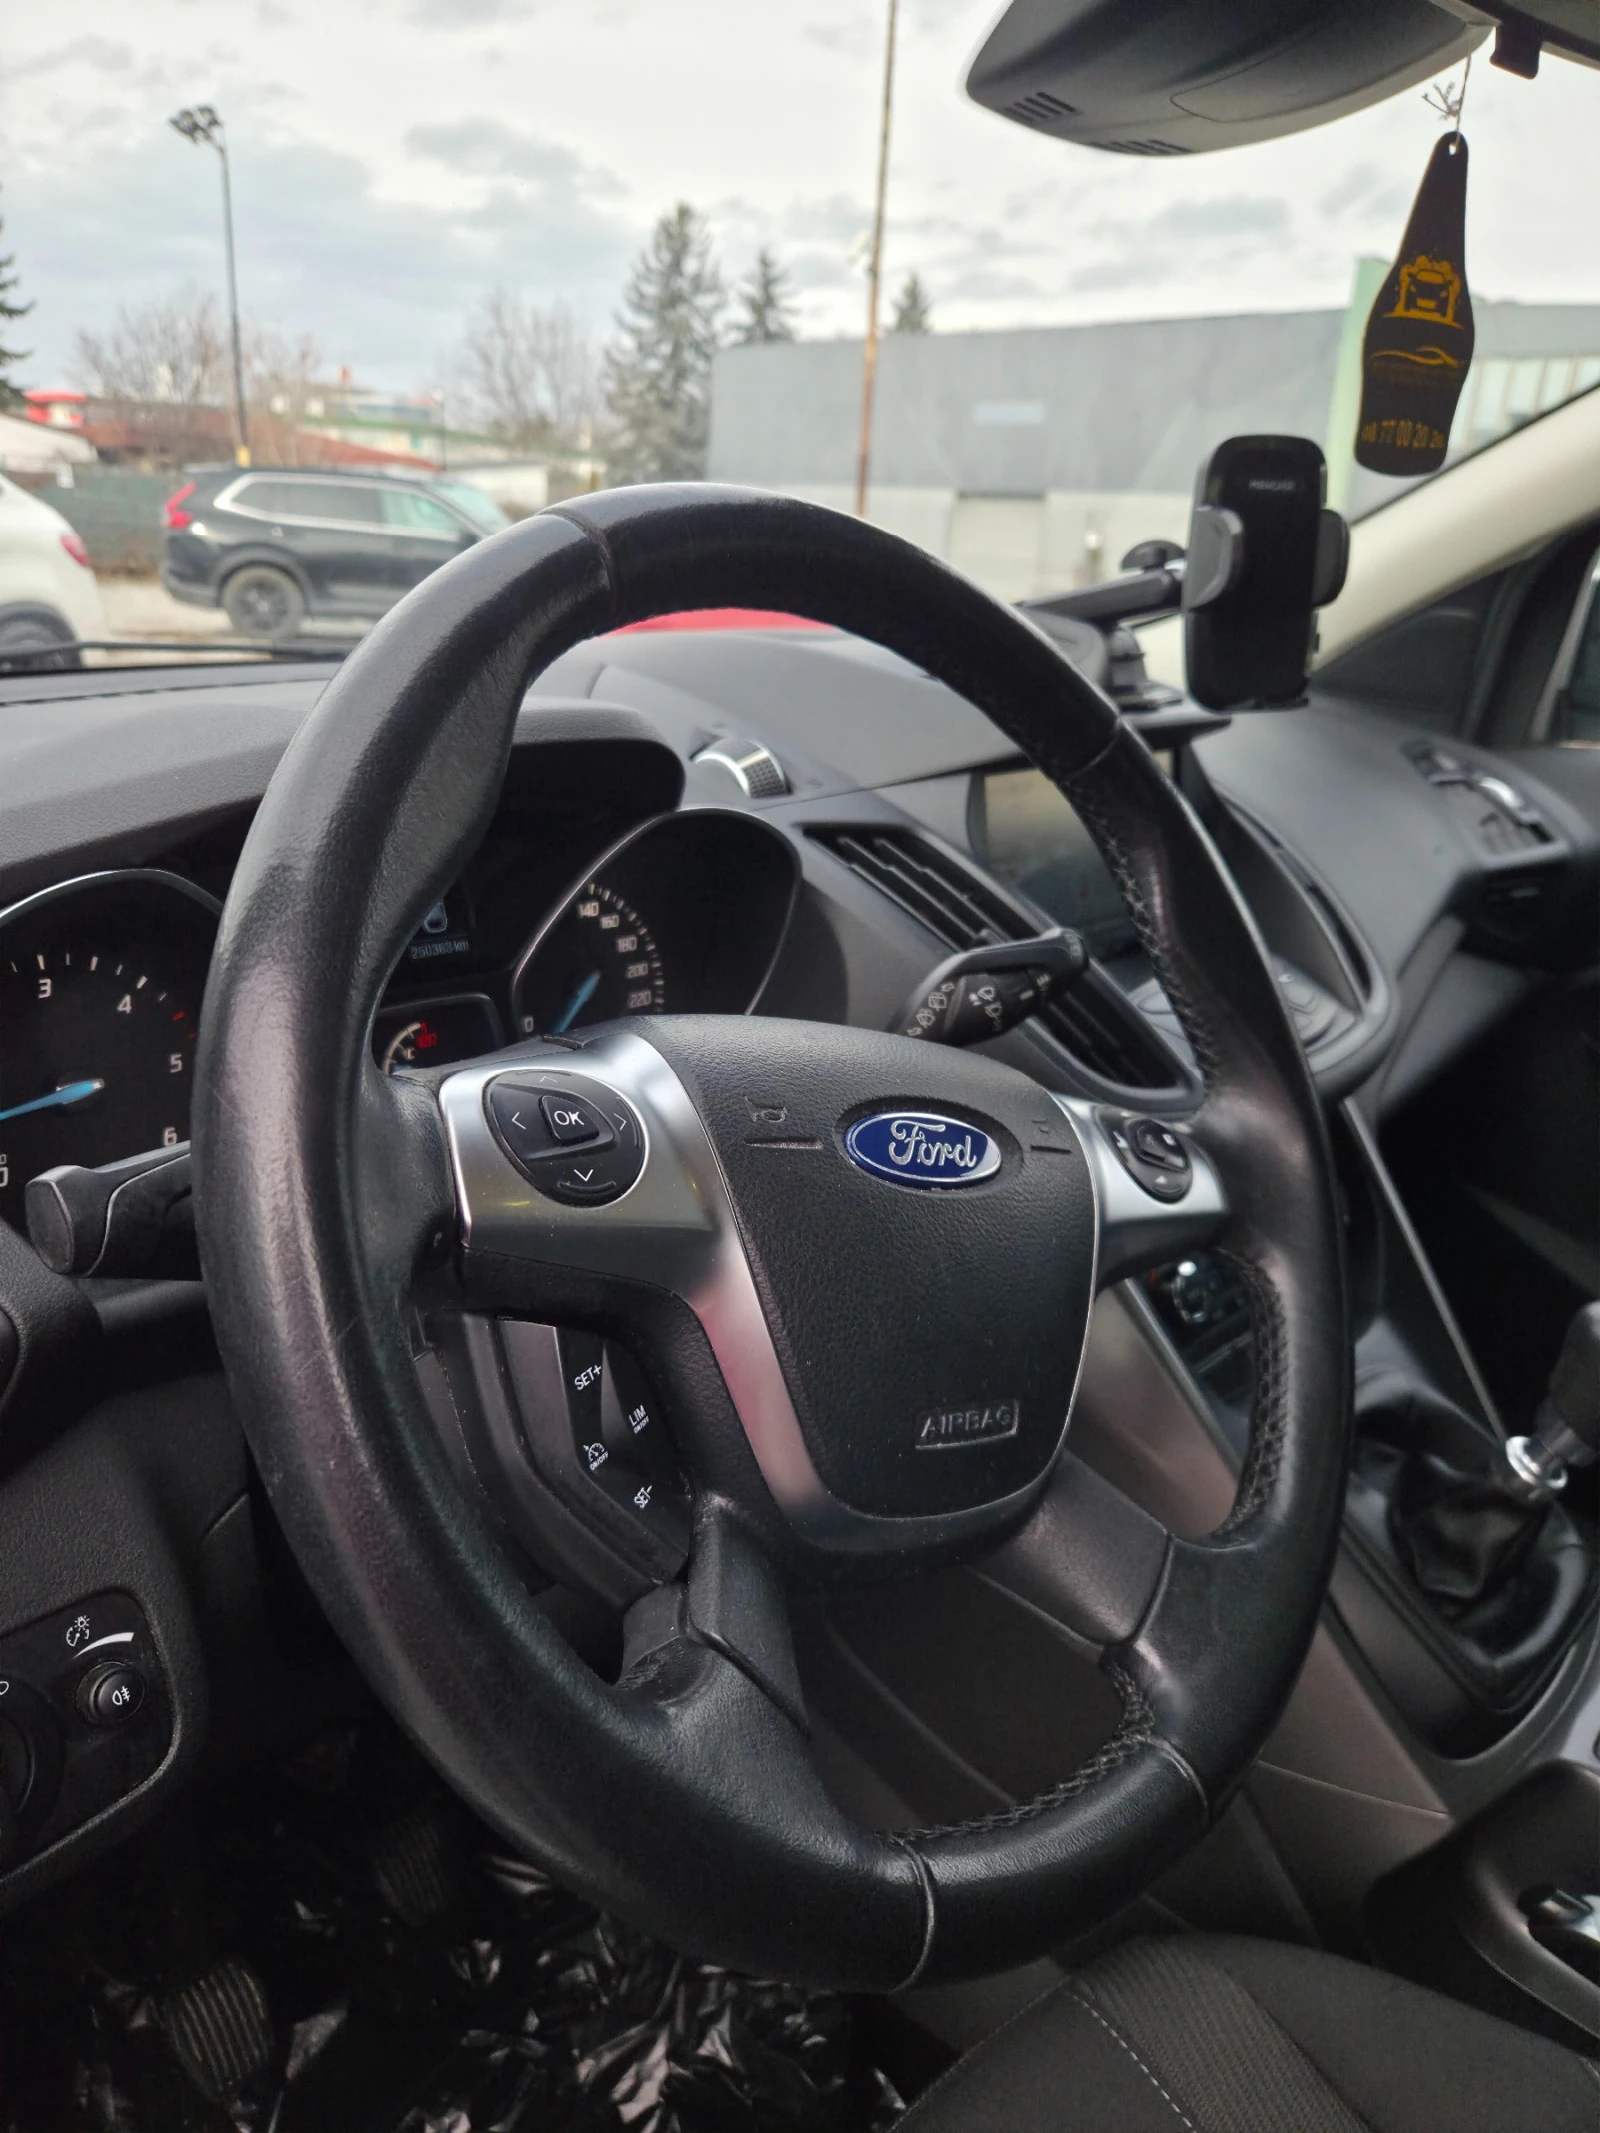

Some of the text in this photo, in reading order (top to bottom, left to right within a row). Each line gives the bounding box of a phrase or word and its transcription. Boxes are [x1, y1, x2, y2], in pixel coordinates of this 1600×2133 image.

[578, 901, 599, 917] 140
[601, 914, 620, 929] 160
[616, 936, 638, 952] 180
[626, 963, 648, 978] 200
[38, 978, 52, 999] 3
[116, 994, 132, 1014] 4
[628, 990, 651, 1008] 220
[524, 1016, 534, 1032] 0
[169, 1053, 183, 1073] 5
[554, 1110, 585, 1126] OK
[163, 1127, 178, 1147] 6
[888, 1119, 977, 1168] Ford
[574, 1364, 602, 1390] SET+
[628, 1404, 647, 1427] LIM
[633, 1415, 650, 1434] ON/OFF
[920, 1405, 1012, 1438] AIRBAG
[589, 1451, 609, 1471] ON/OFF
